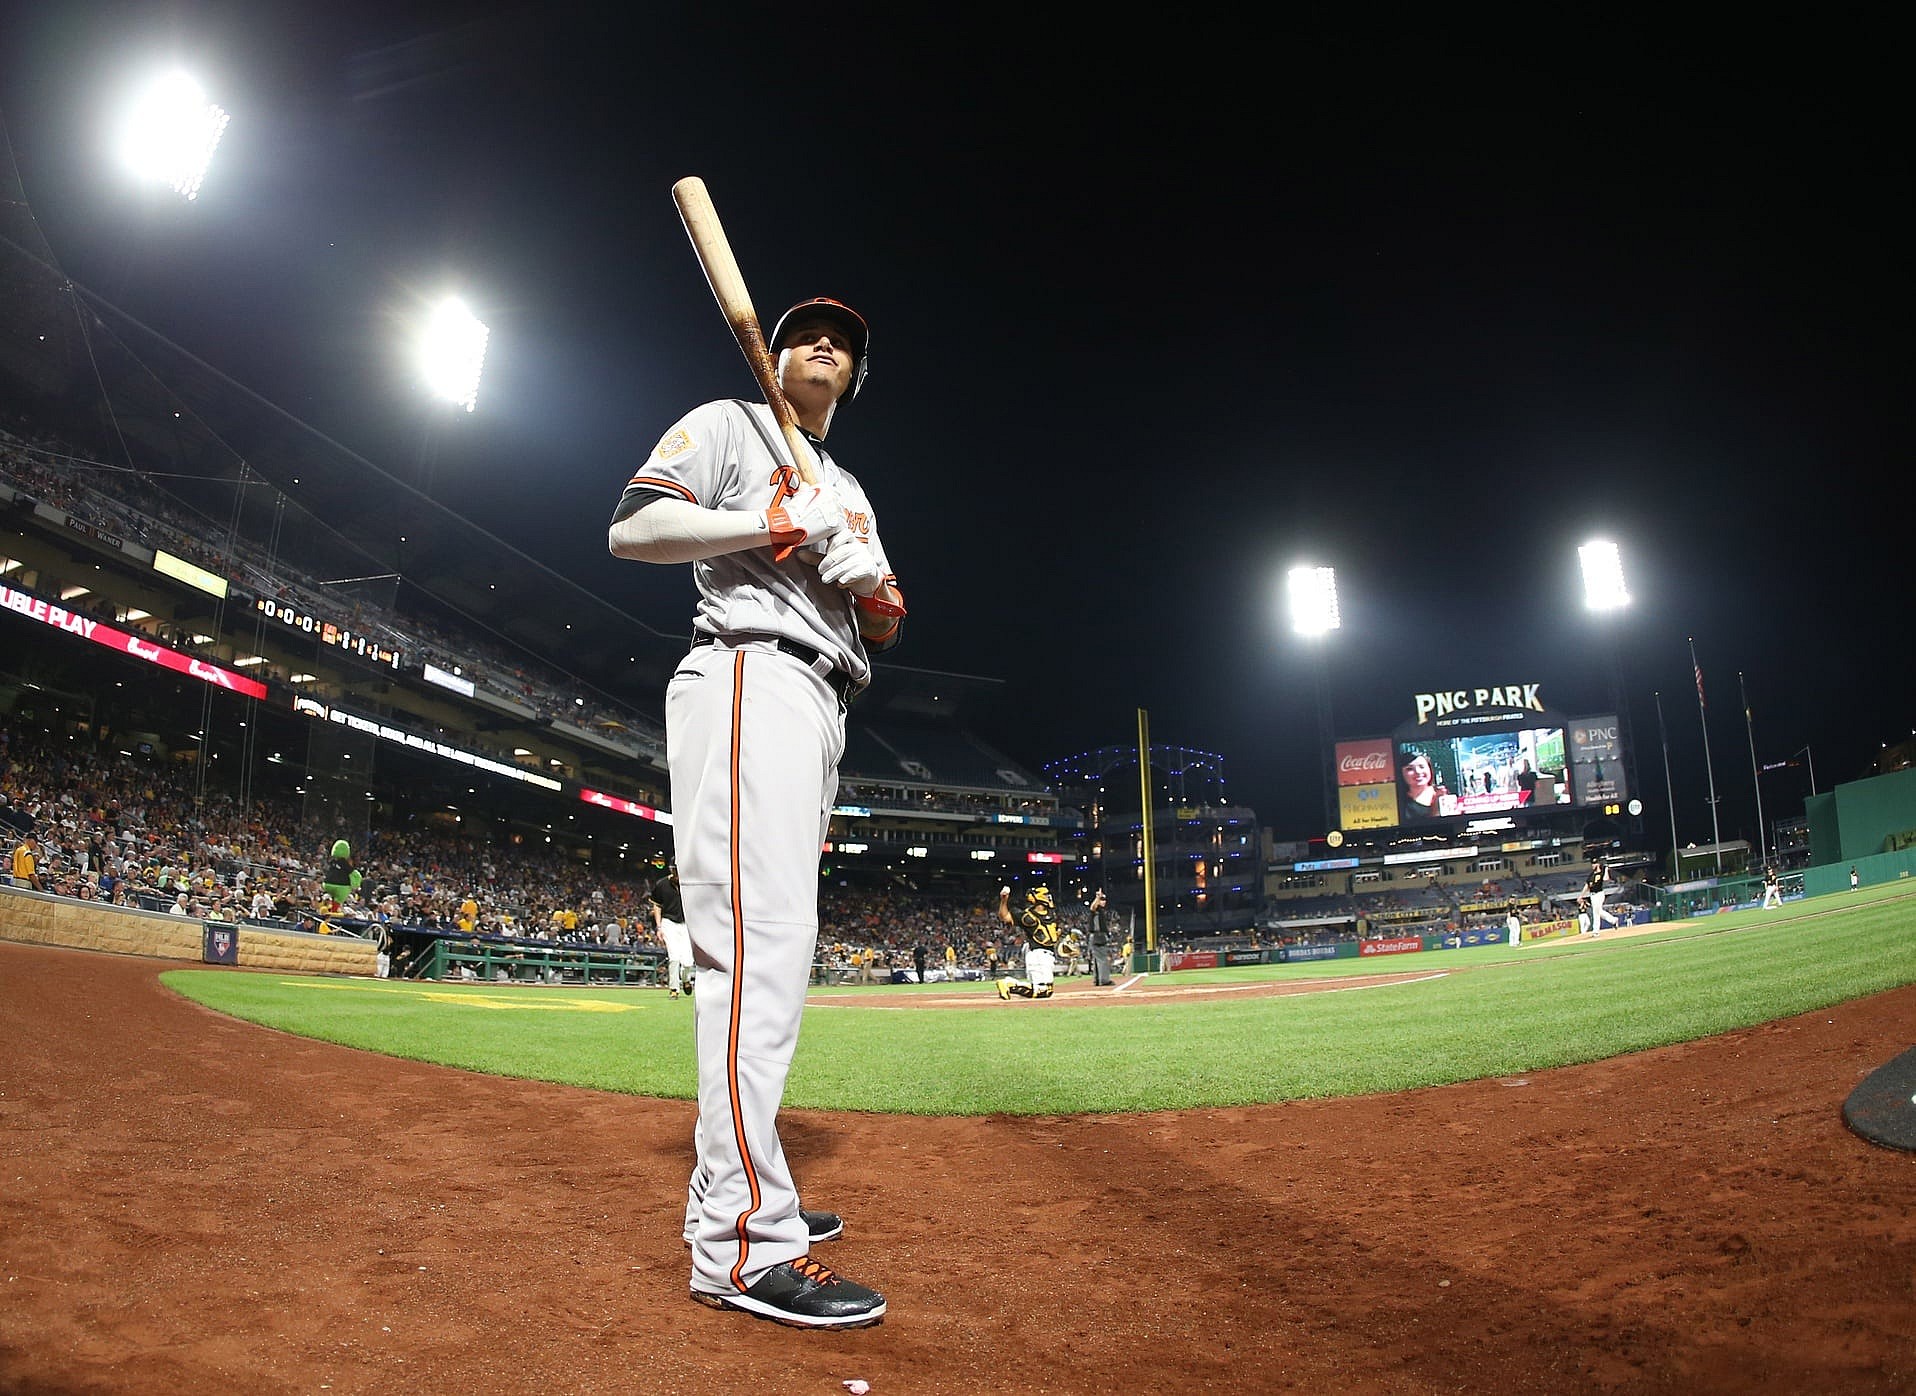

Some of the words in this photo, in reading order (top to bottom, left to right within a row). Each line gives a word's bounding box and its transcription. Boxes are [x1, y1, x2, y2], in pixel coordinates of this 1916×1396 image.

[69, 518, 87, 533] PAUL
[97, 532, 121, 548] WANER
[0, 585, 48, 621] UBLE
[48, 605, 96, 638] PLAY
[264, 600, 276, 617] 0
[283, 608, 295, 625] 0
[302, 616, 313, 633] 0
[1415, 690, 1470, 725] PNC
[1474, 684, 1545, 713] PARK
[1452, 718, 1460, 726] OF
[1461, 717, 1471, 725] THE
[1588, 727, 1617, 741] PNC
[1376, 943, 1398, 953] State
[1399, 941, 1418, 951] Farm
